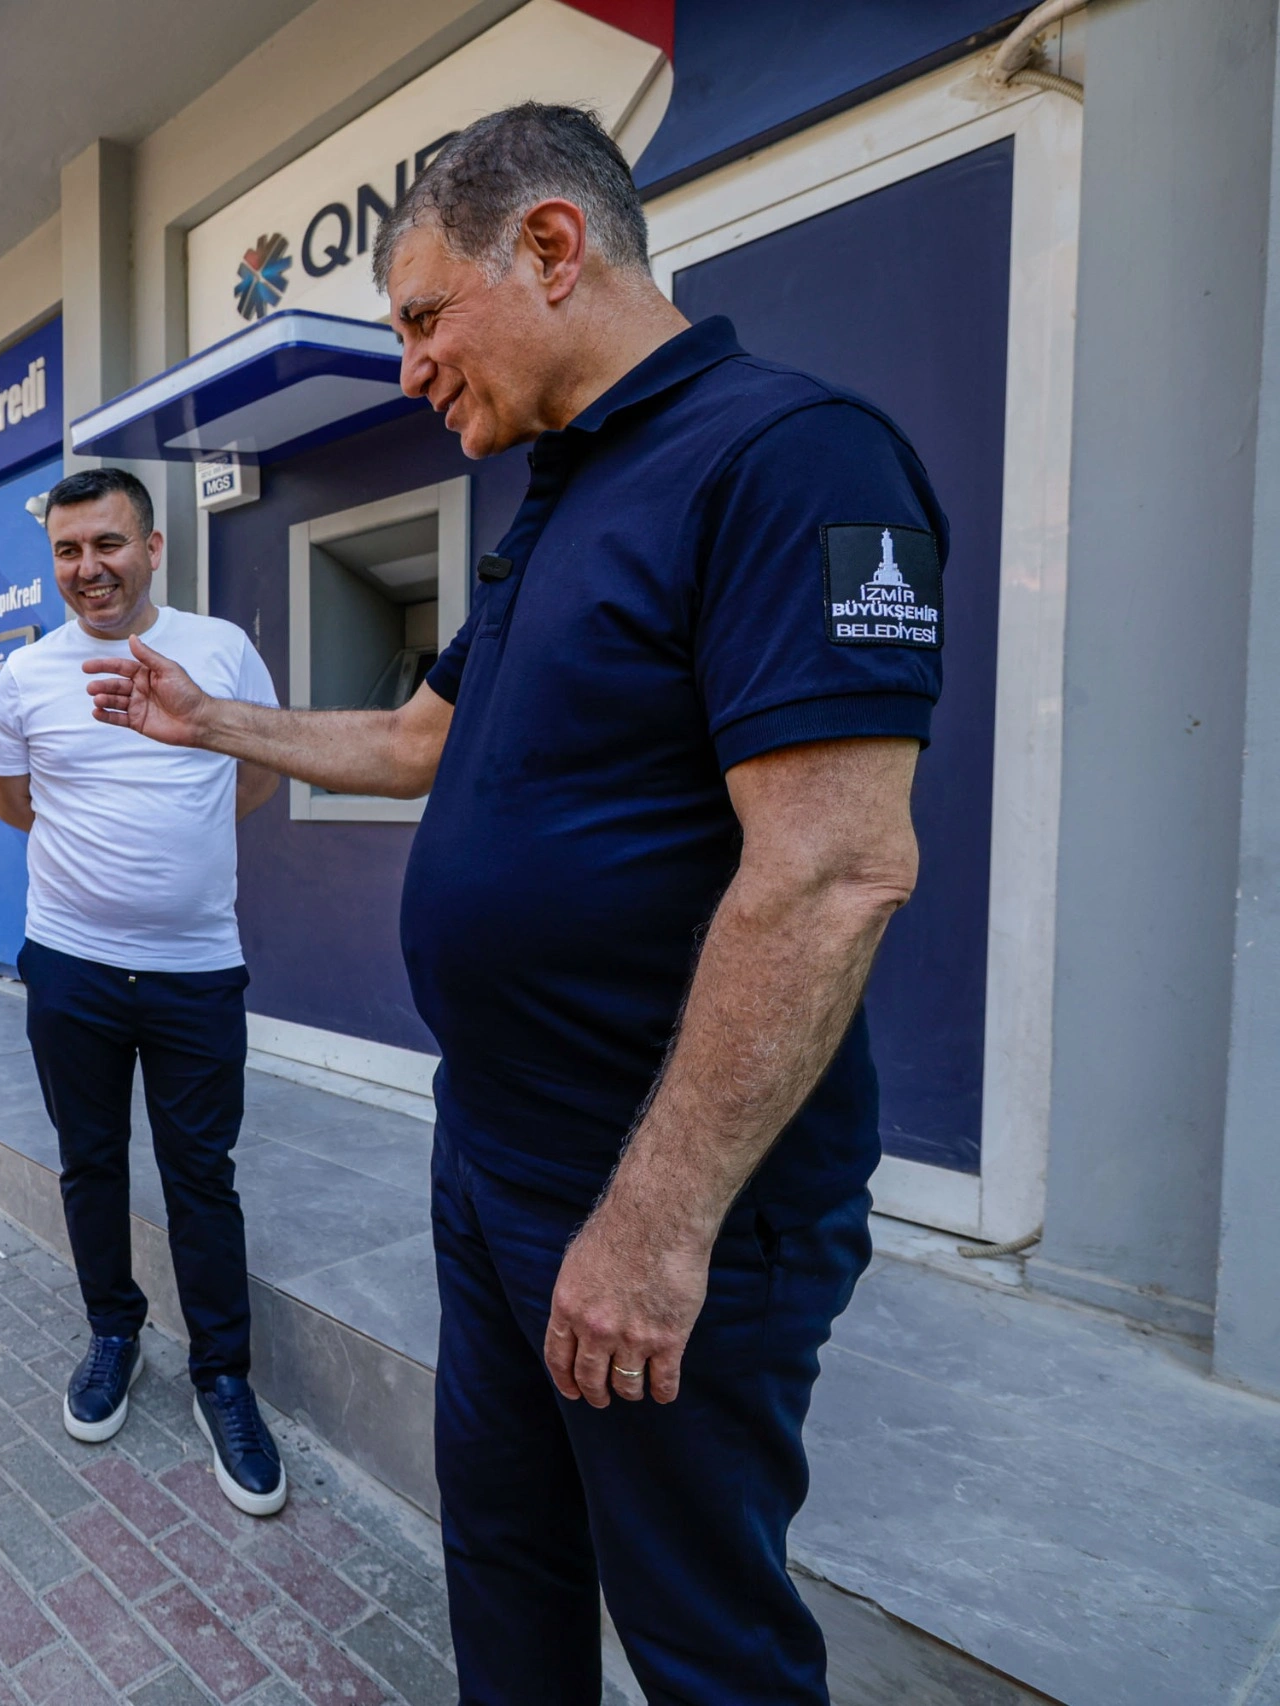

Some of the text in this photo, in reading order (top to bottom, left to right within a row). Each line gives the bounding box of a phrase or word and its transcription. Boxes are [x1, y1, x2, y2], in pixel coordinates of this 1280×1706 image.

[206, 475, 231, 496] MGS
[860, 584, 915, 603] İZMİR
[832, 600, 938, 622] BÜYÜKŞEHİR
[836, 622, 937, 644] BELEDİYESİ
